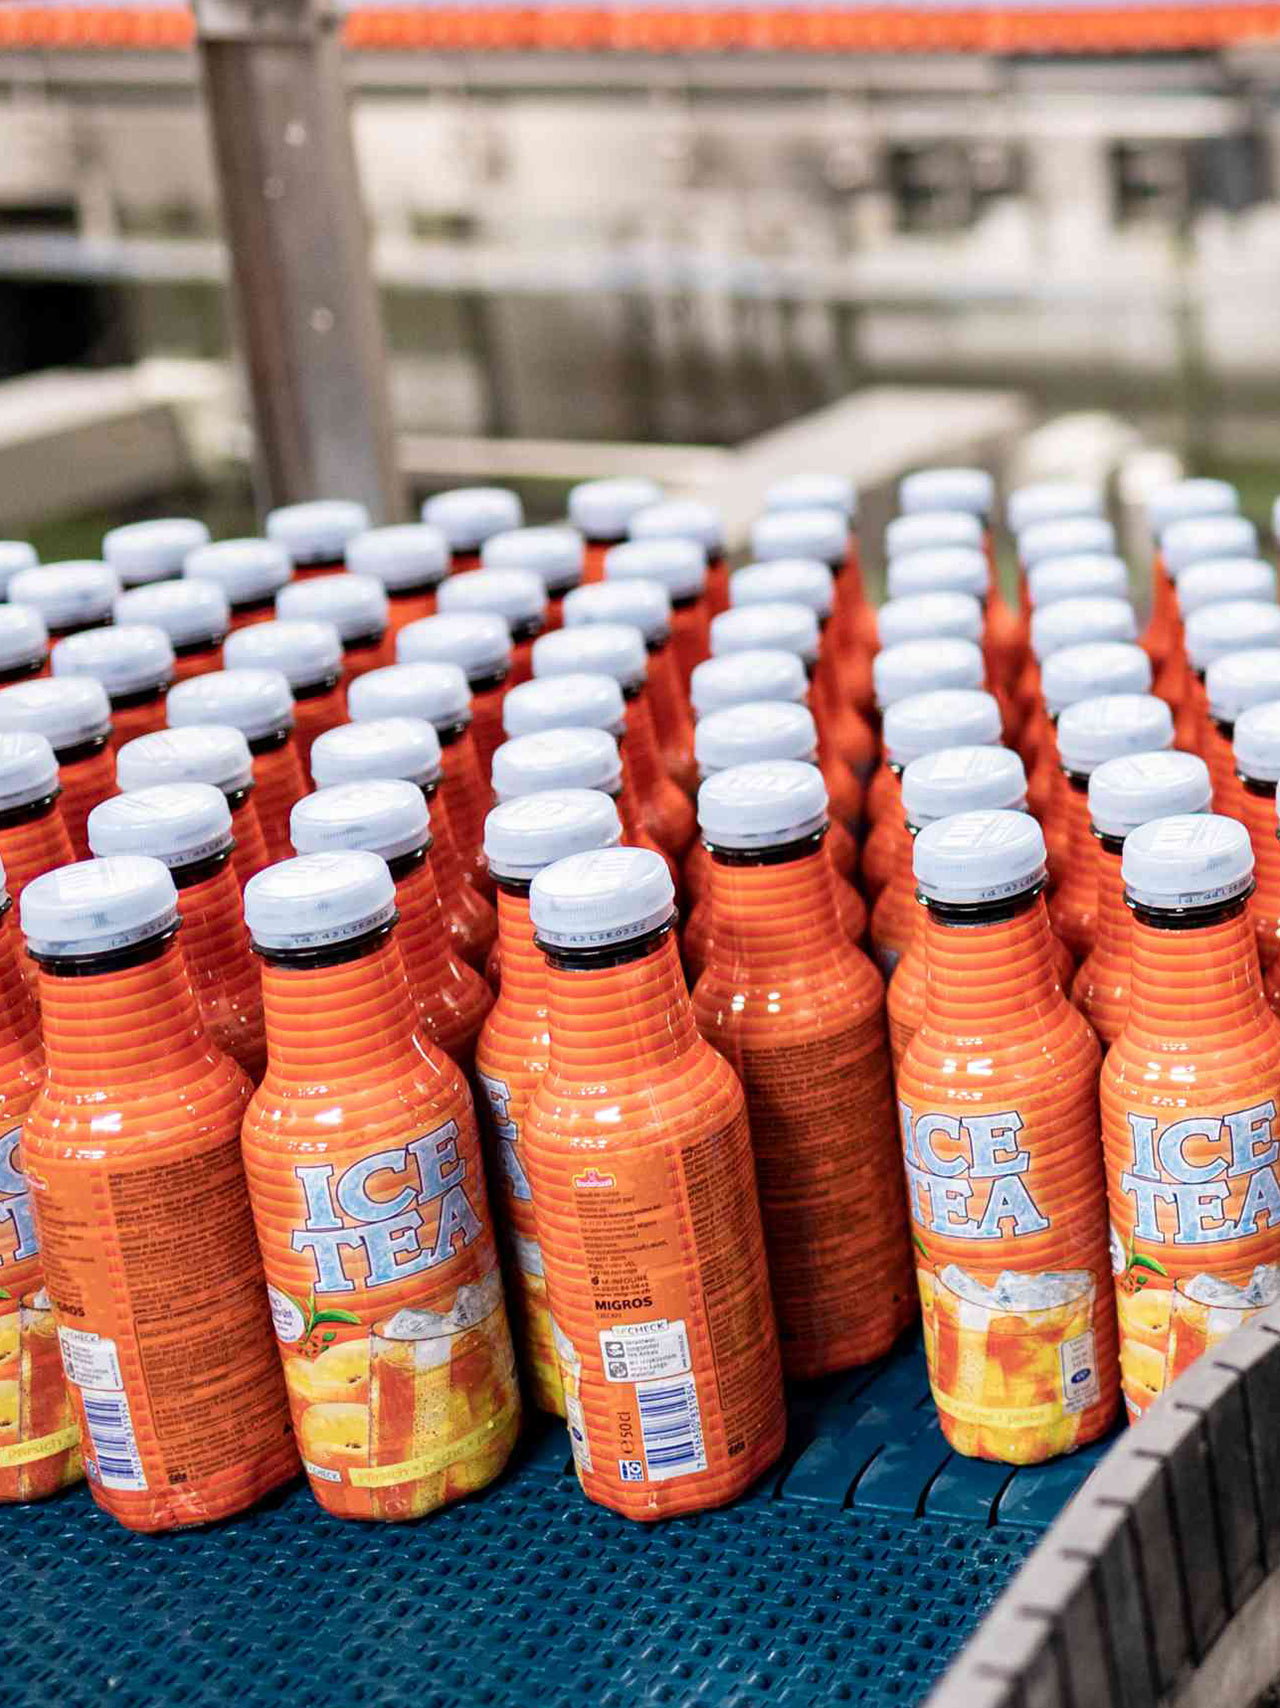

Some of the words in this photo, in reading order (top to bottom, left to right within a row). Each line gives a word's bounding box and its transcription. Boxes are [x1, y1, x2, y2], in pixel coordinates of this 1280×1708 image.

[294, 1118, 467, 1231] ICE
[899, 1099, 1031, 1179] ICE
[1127, 1100, 1280, 1184] ICE
[291, 1184, 483, 1293] TEA
[904, 1158, 1050, 1240] TEA
[594, 1296, 653, 1312] MIGROS
